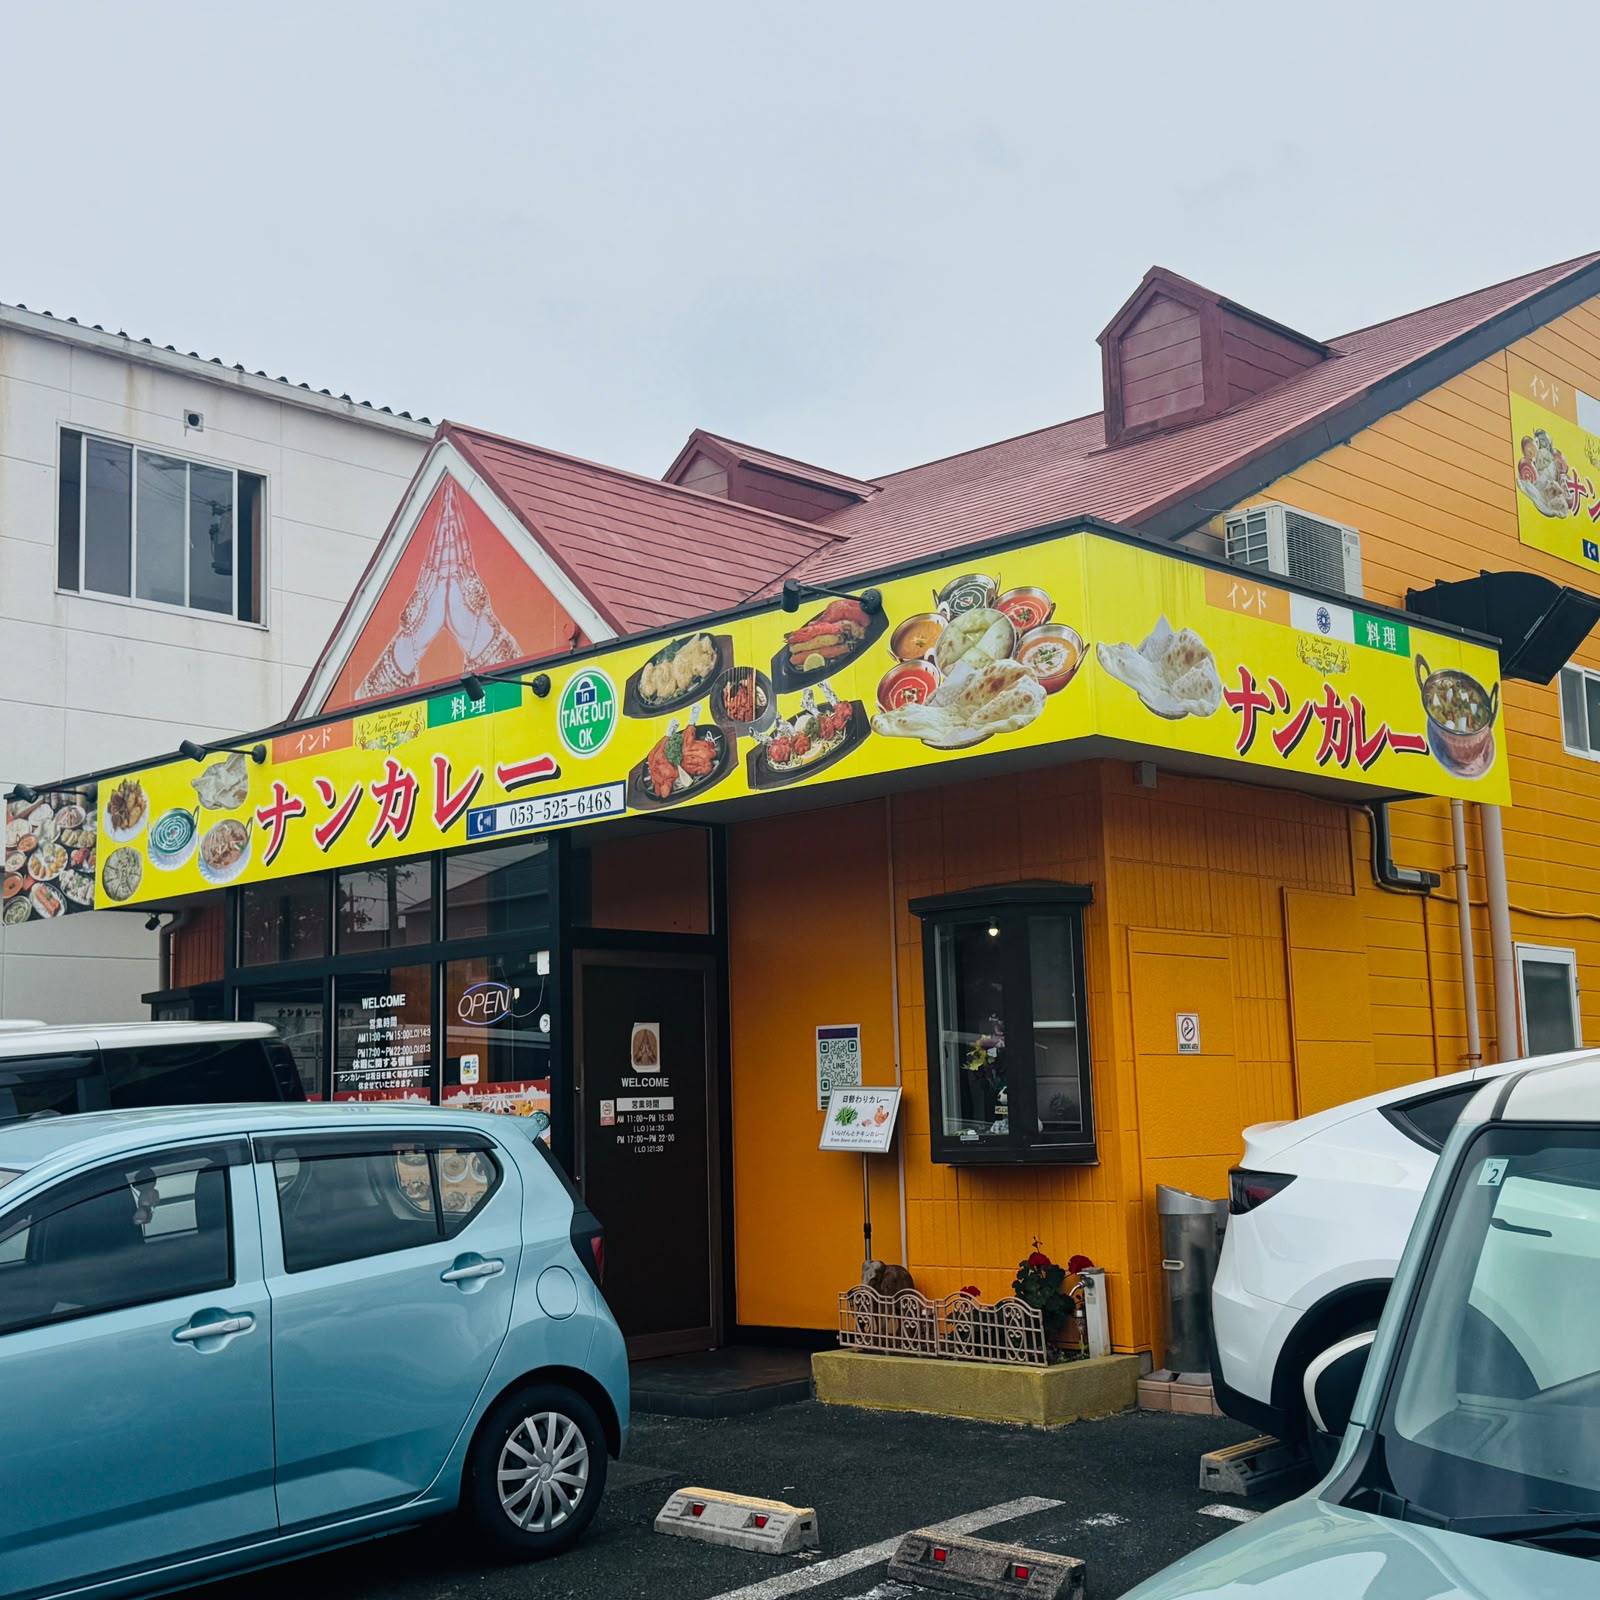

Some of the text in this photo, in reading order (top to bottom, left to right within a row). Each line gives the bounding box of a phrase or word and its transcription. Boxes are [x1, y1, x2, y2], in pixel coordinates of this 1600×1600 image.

[1530, 375, 1559, 407] インド
[1227, 582, 1267, 616] インド
[1366, 620, 1397, 652] 料理
[451, 696, 487, 720] 料理
[562, 700, 612, 729] TAKE OUT
[1223, 664, 1430, 771] ナンカレー
[295, 727, 332, 753] インド
[579, 728, 593, 748] OK
[256, 754, 560, 866] ナンカレー
[510, 790, 612, 826] 053-525-6468
[361, 993, 406, 1010] WELCOME
[458, 990, 511, 1018] OPEN
[369, 1015, 398, 1030] 営業時間
[621, 1077, 670, 1088] WELCOME
[842, 1095, 889, 1104] 日替わりカレー
[617, 1115, 624, 1123] AM
[658, 1113, 674, 1122] 15:00
[617, 1135, 625, 1144] PM
[658, 1133, 675, 1142] 22:00
[1487, 1168, 1499, 1184] 2
